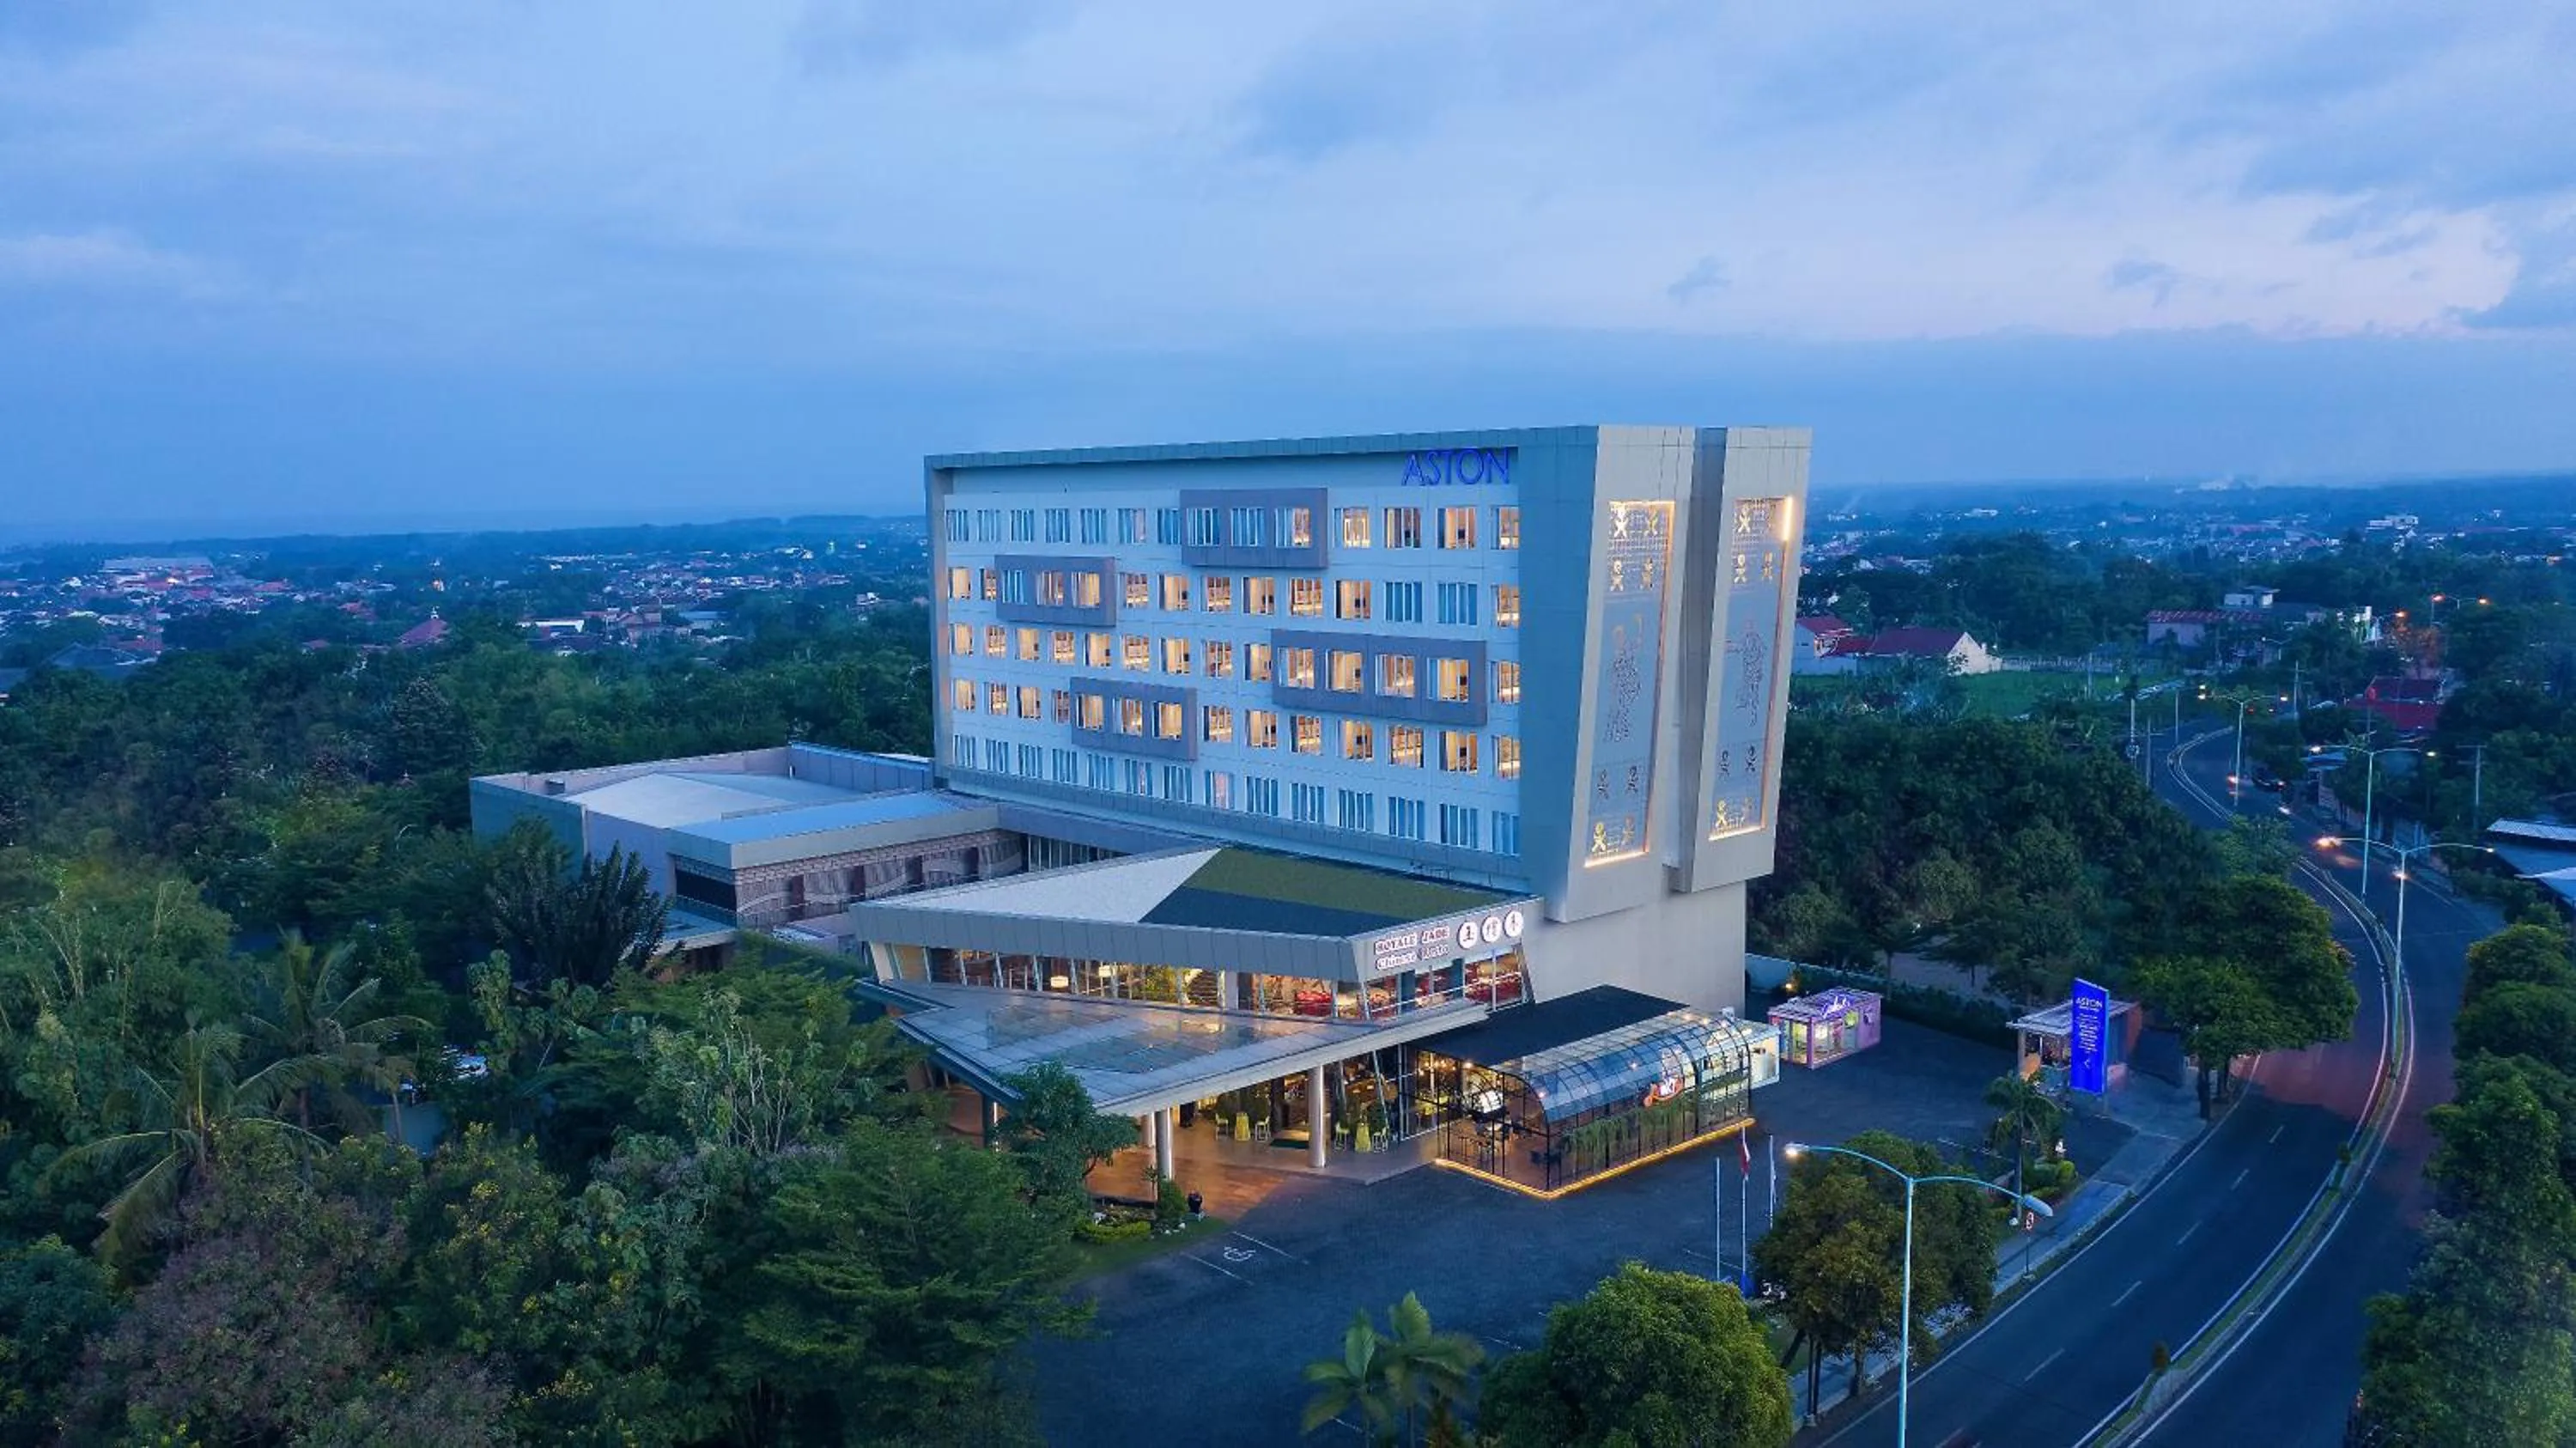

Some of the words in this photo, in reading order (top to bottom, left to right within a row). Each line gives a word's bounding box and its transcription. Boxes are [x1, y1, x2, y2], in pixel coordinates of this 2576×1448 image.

[1401, 448, 1510, 486] ASTON
[1421, 926, 1450, 944] JADE
[2075, 996, 2103, 1008] ASTON
